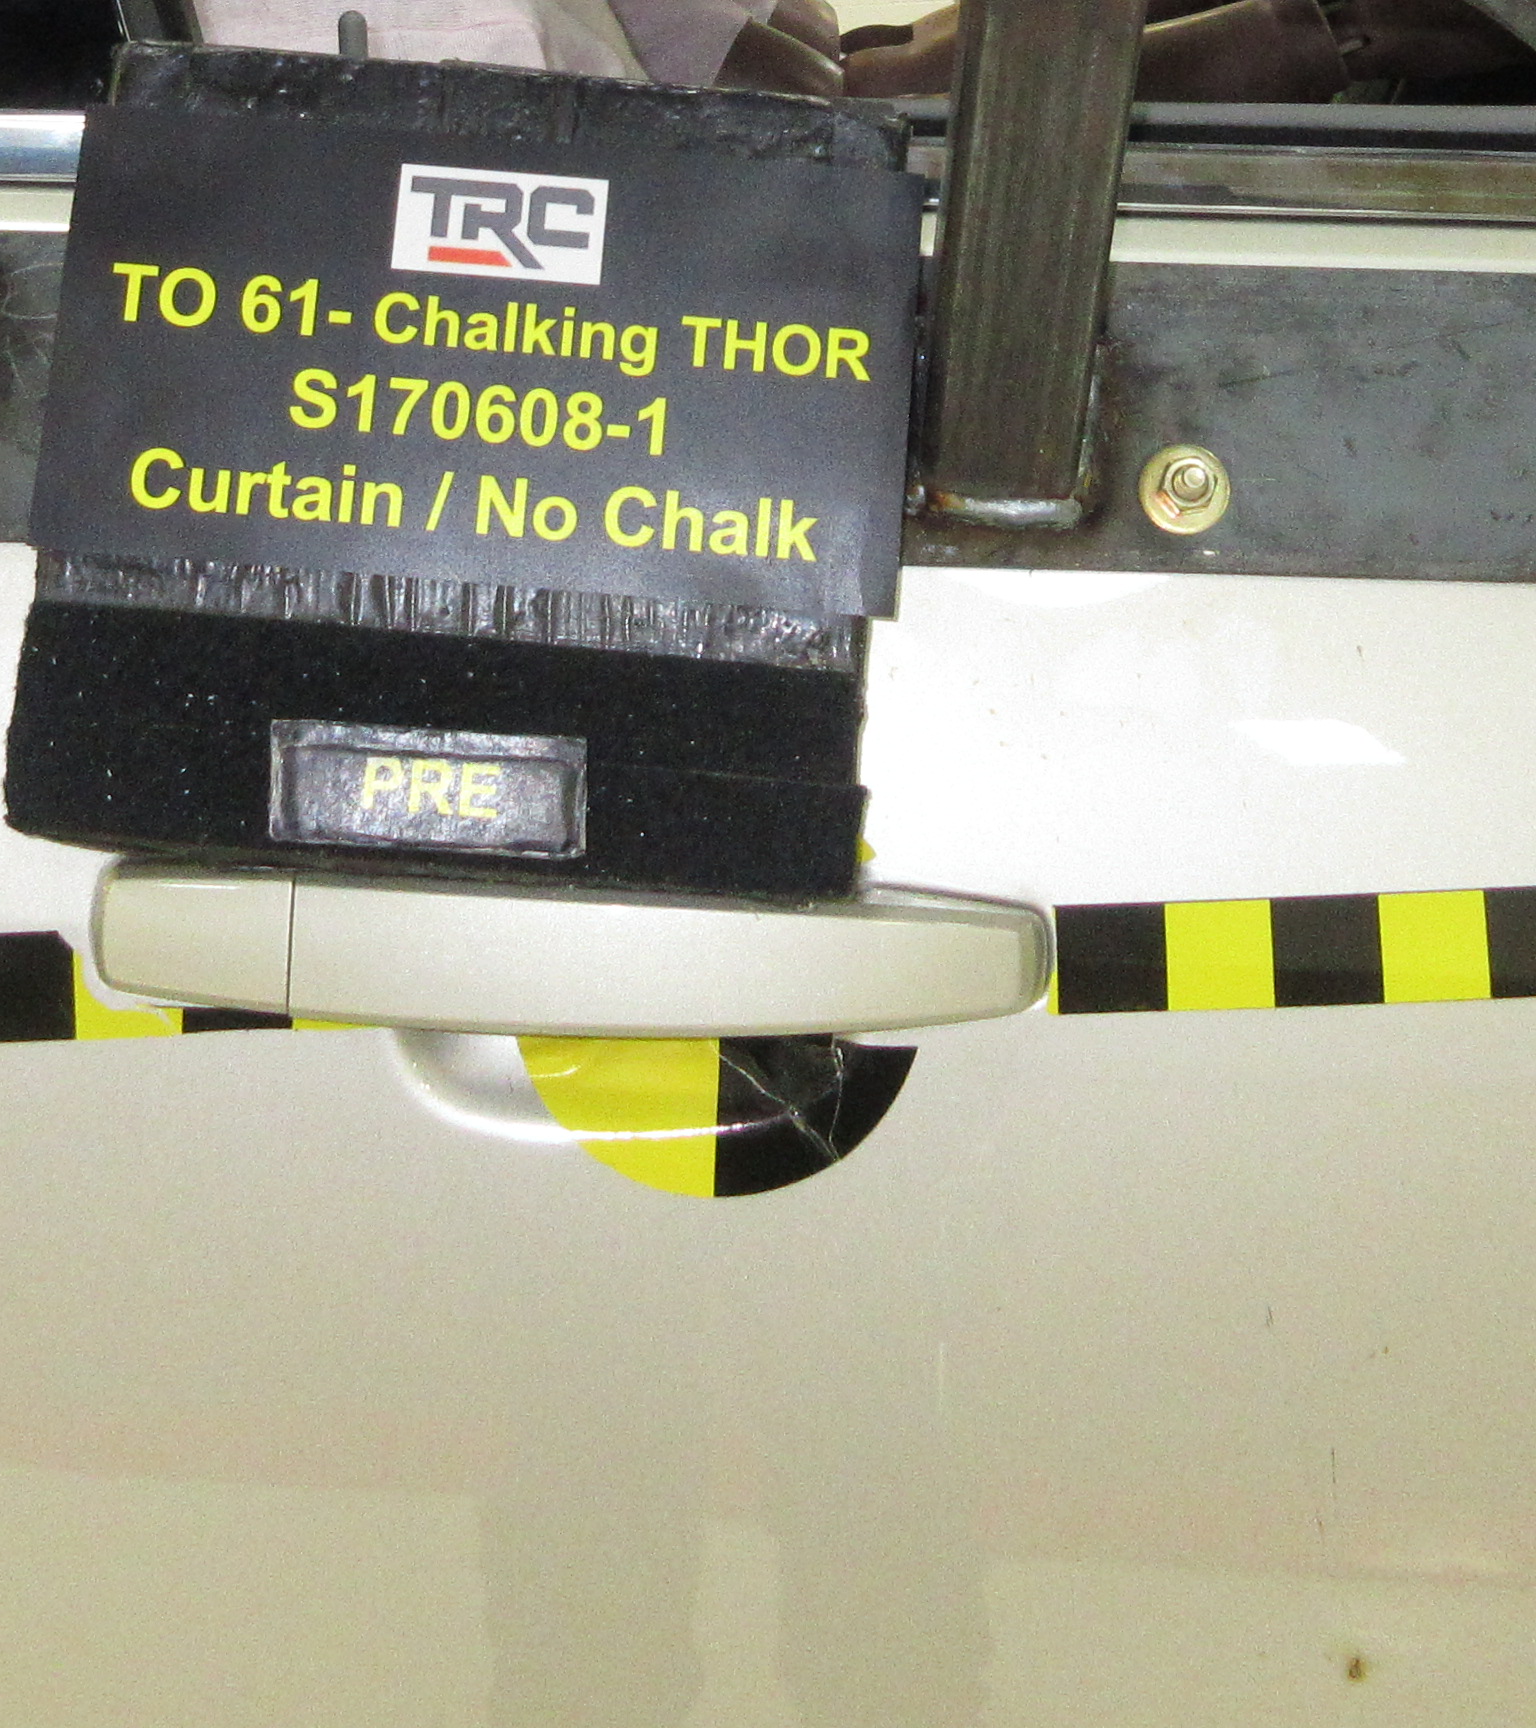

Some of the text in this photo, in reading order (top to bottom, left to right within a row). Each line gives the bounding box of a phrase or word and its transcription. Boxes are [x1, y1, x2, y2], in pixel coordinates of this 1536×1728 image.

[411, 175, 595, 270] TRC
[112, 263, 871, 382] TO 61- Chalking THOR
[289, 368, 667, 455] S170608-1
[129, 447, 817, 562] Curtain / No Chalk
[361, 756, 503, 820] PRE
